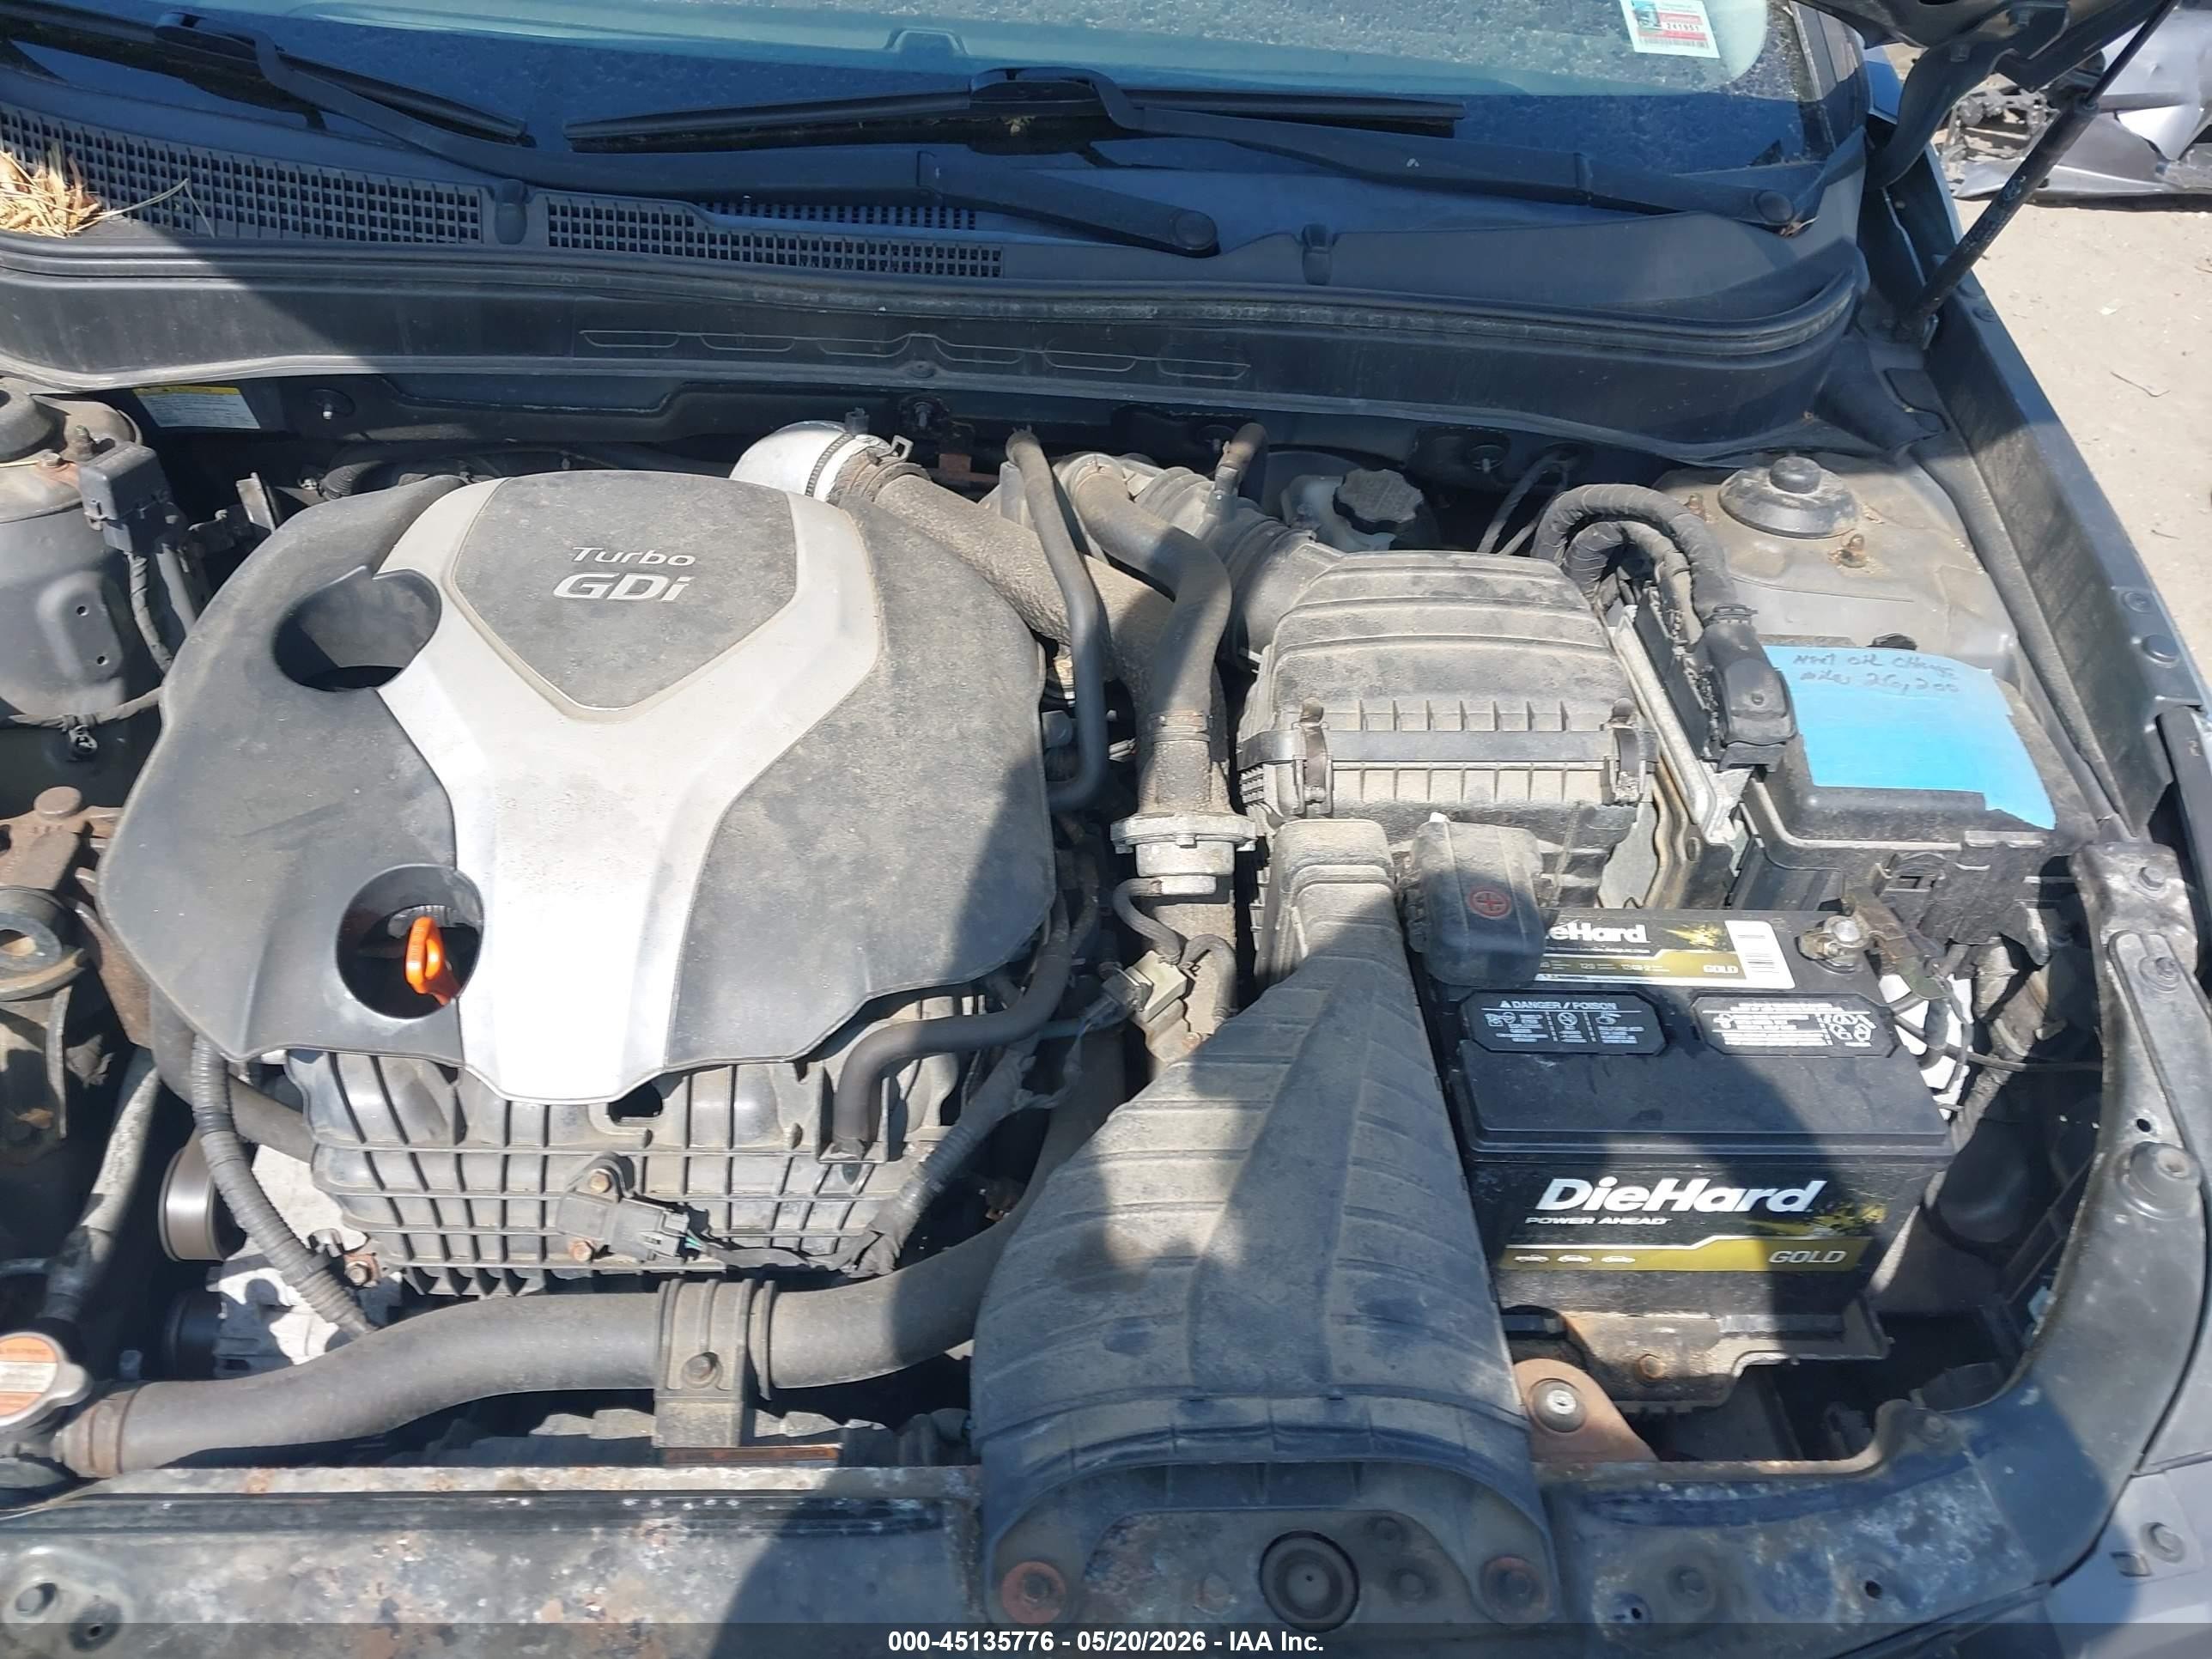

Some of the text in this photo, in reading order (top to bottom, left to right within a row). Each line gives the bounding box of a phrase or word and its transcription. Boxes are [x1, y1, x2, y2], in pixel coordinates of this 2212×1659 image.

[573, 547, 696, 566] Turbo
[553, 573, 696, 601] GDi
[1545, 922, 1649, 944] eHard
[1703, 964, 1739, 974] GOLD
[1511, 1000, 1562, 1010] DANGER
[1572, 1002, 1618, 1011] POISON
[1535, 1176, 1828, 1213] DieHard
[1597, 1216, 1668, 1225] AHEAD
[1769, 1250, 1847, 1265] GOLD
